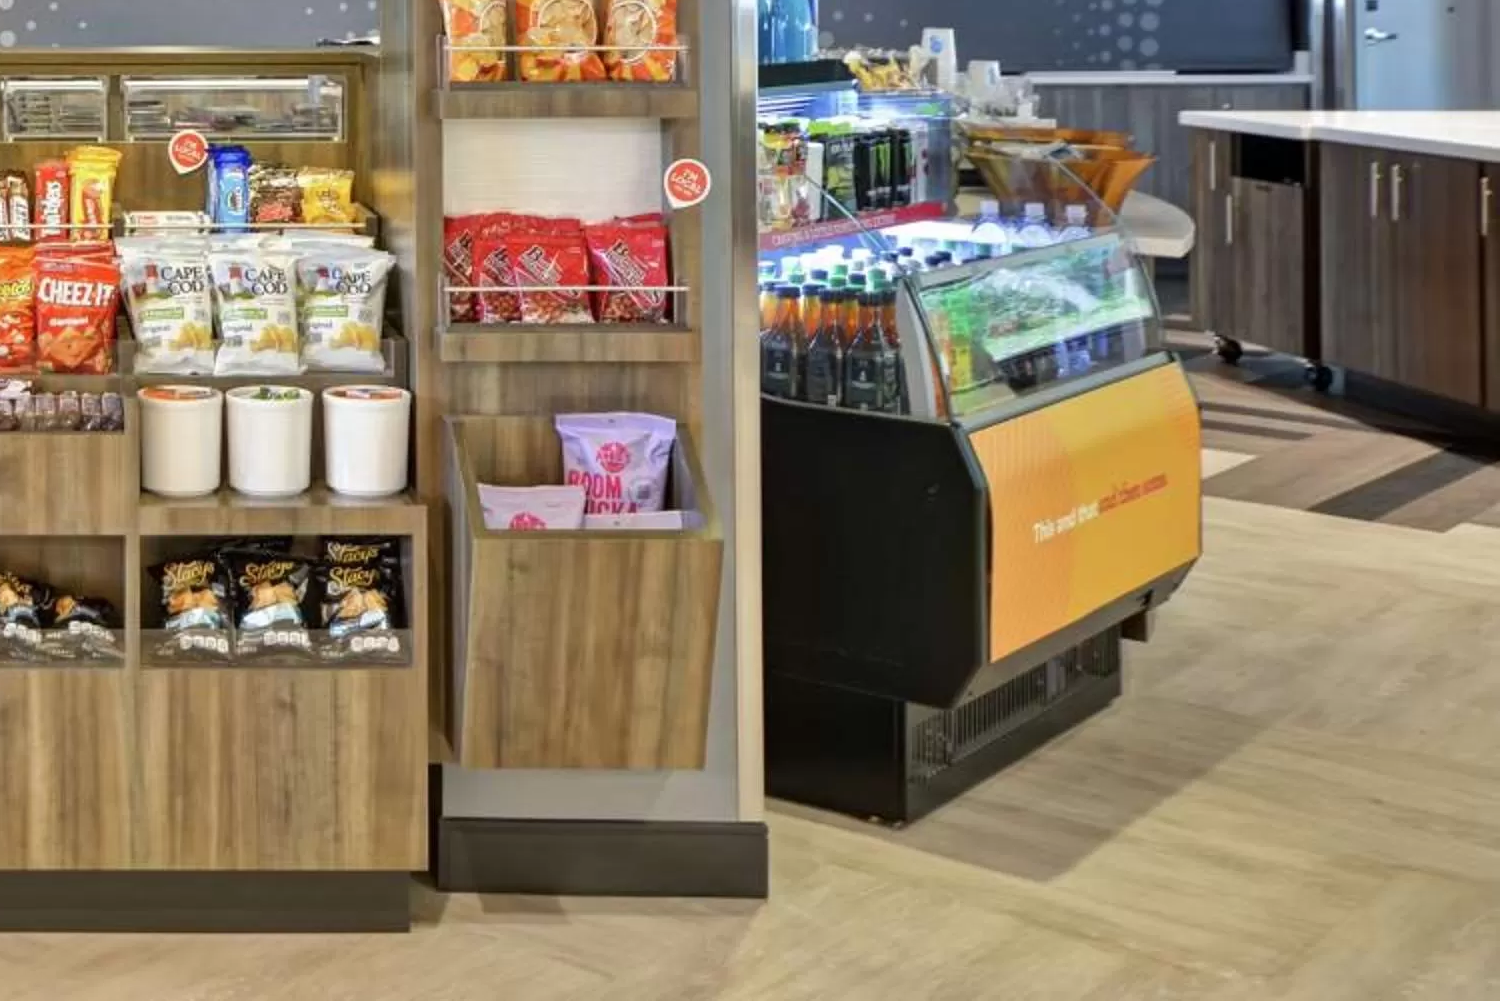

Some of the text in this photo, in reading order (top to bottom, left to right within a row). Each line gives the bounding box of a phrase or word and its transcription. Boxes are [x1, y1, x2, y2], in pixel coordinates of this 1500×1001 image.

[161, 266, 203, 282] CAPE
[167, 281, 204, 296] COD
[251, 281, 287, 296] COD
[335, 281, 372, 296] COD
